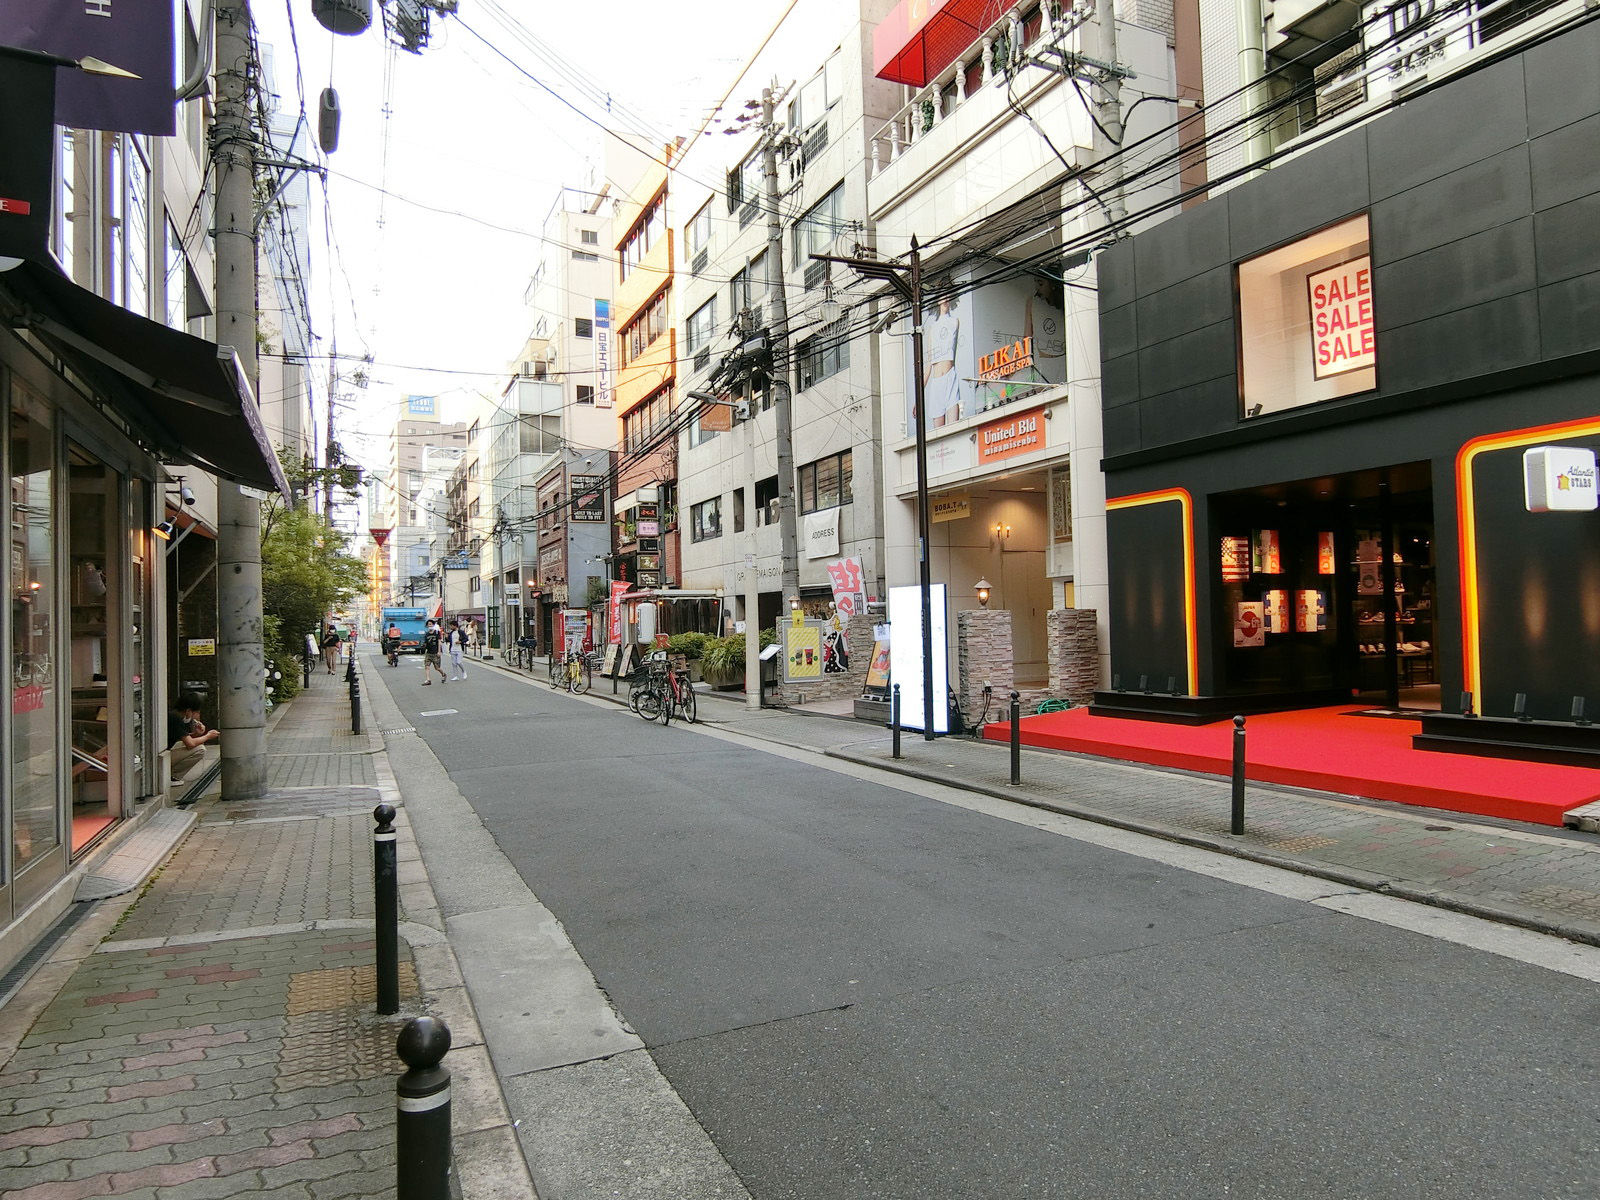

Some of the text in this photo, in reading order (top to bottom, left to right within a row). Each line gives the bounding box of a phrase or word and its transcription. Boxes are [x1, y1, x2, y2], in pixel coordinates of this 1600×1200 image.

[1314, 269, 1370, 310] SALE
[1316, 298, 1372, 338] SALE
[978, 336, 1032, 375] ILIKAI
[1318, 328, 1375, 366] SALE
[984, 416, 1037, 445] United Bld
[984, 435, 1037, 456] minamisenba
[1567, 465, 1594, 477] Atlantic
[1571, 477, 1592, 488] STARS
[812, 527, 835, 540] ADDRESS
